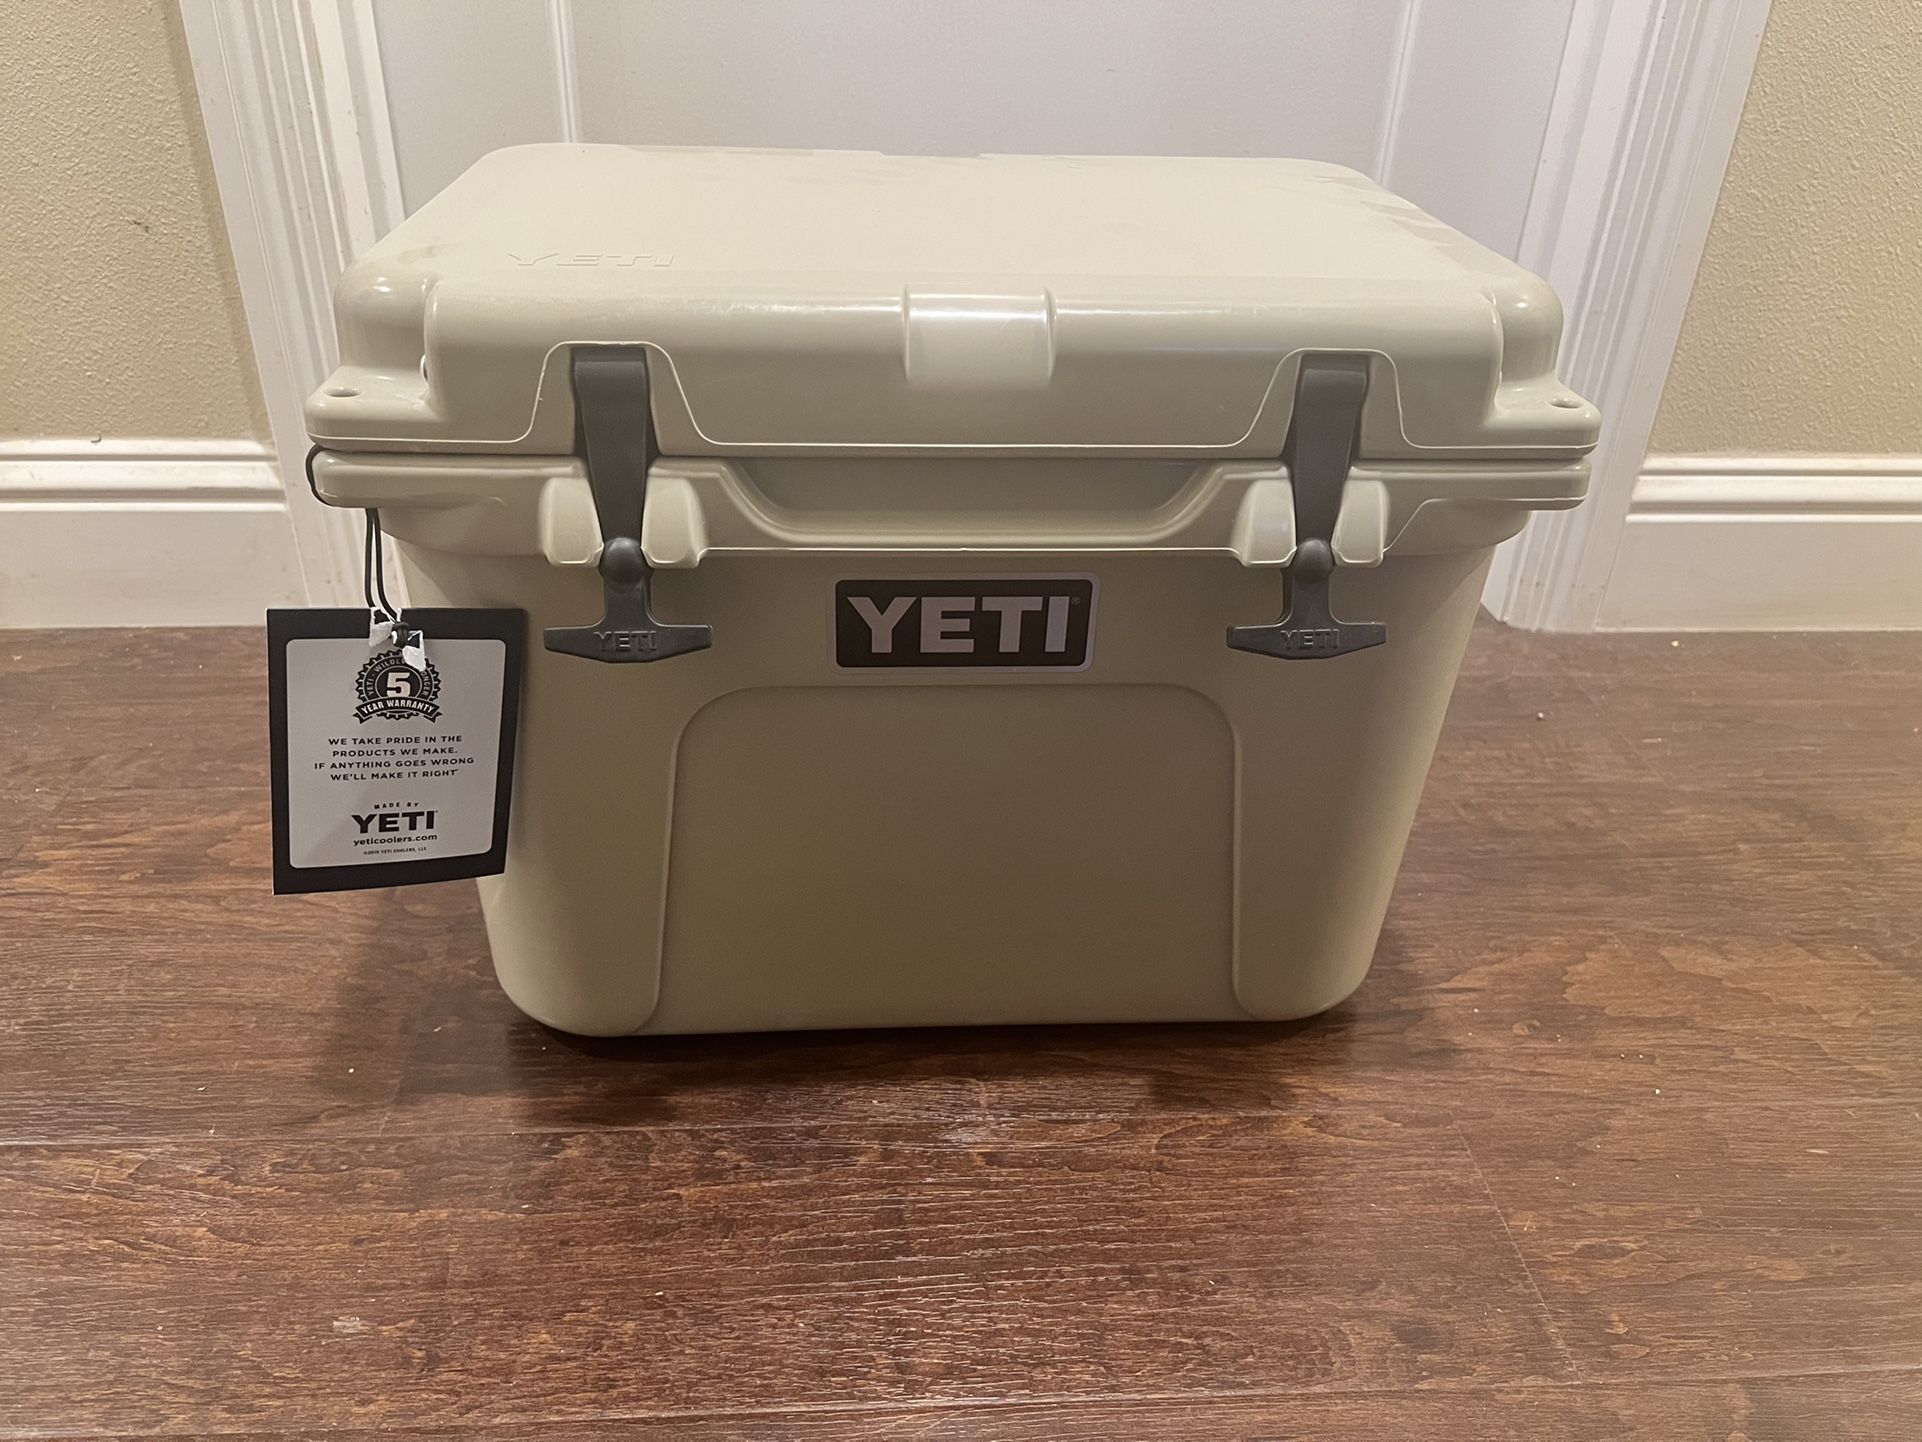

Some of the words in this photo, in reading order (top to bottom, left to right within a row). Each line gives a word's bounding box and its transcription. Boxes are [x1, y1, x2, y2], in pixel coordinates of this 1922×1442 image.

[847, 596, 1070, 653] YETI
[593, 630, 657, 651] YETI
[1280, 628, 1340, 649] YETI
[386, 672, 411, 698] 5
[361, 701, 384, 714] YEAR
[386, 699, 435, 714] WARRANTY
[328, 738, 347, 746] WE
[352, 737, 382, 745] TAKE
[386, 736, 421, 744] PRIDE
[332, 749, 396, 758] PRODUCTS
[400, 748, 418, 756] WE
[423, 747, 458, 755] MAKE.
[314, 762, 325, 770] IF
[330, 760, 391, 769] ANYTHING
[395, 759, 426, 767] GOES
[431, 757, 475, 766] WRONG
[330, 773, 367, 781] WE'LL
[371, 771, 403, 780] MAKE
[374, 801, 400, 809] MADE
[351, 810, 435, 834] YETI
[353, 834, 438, 847] yeticoolers.com
